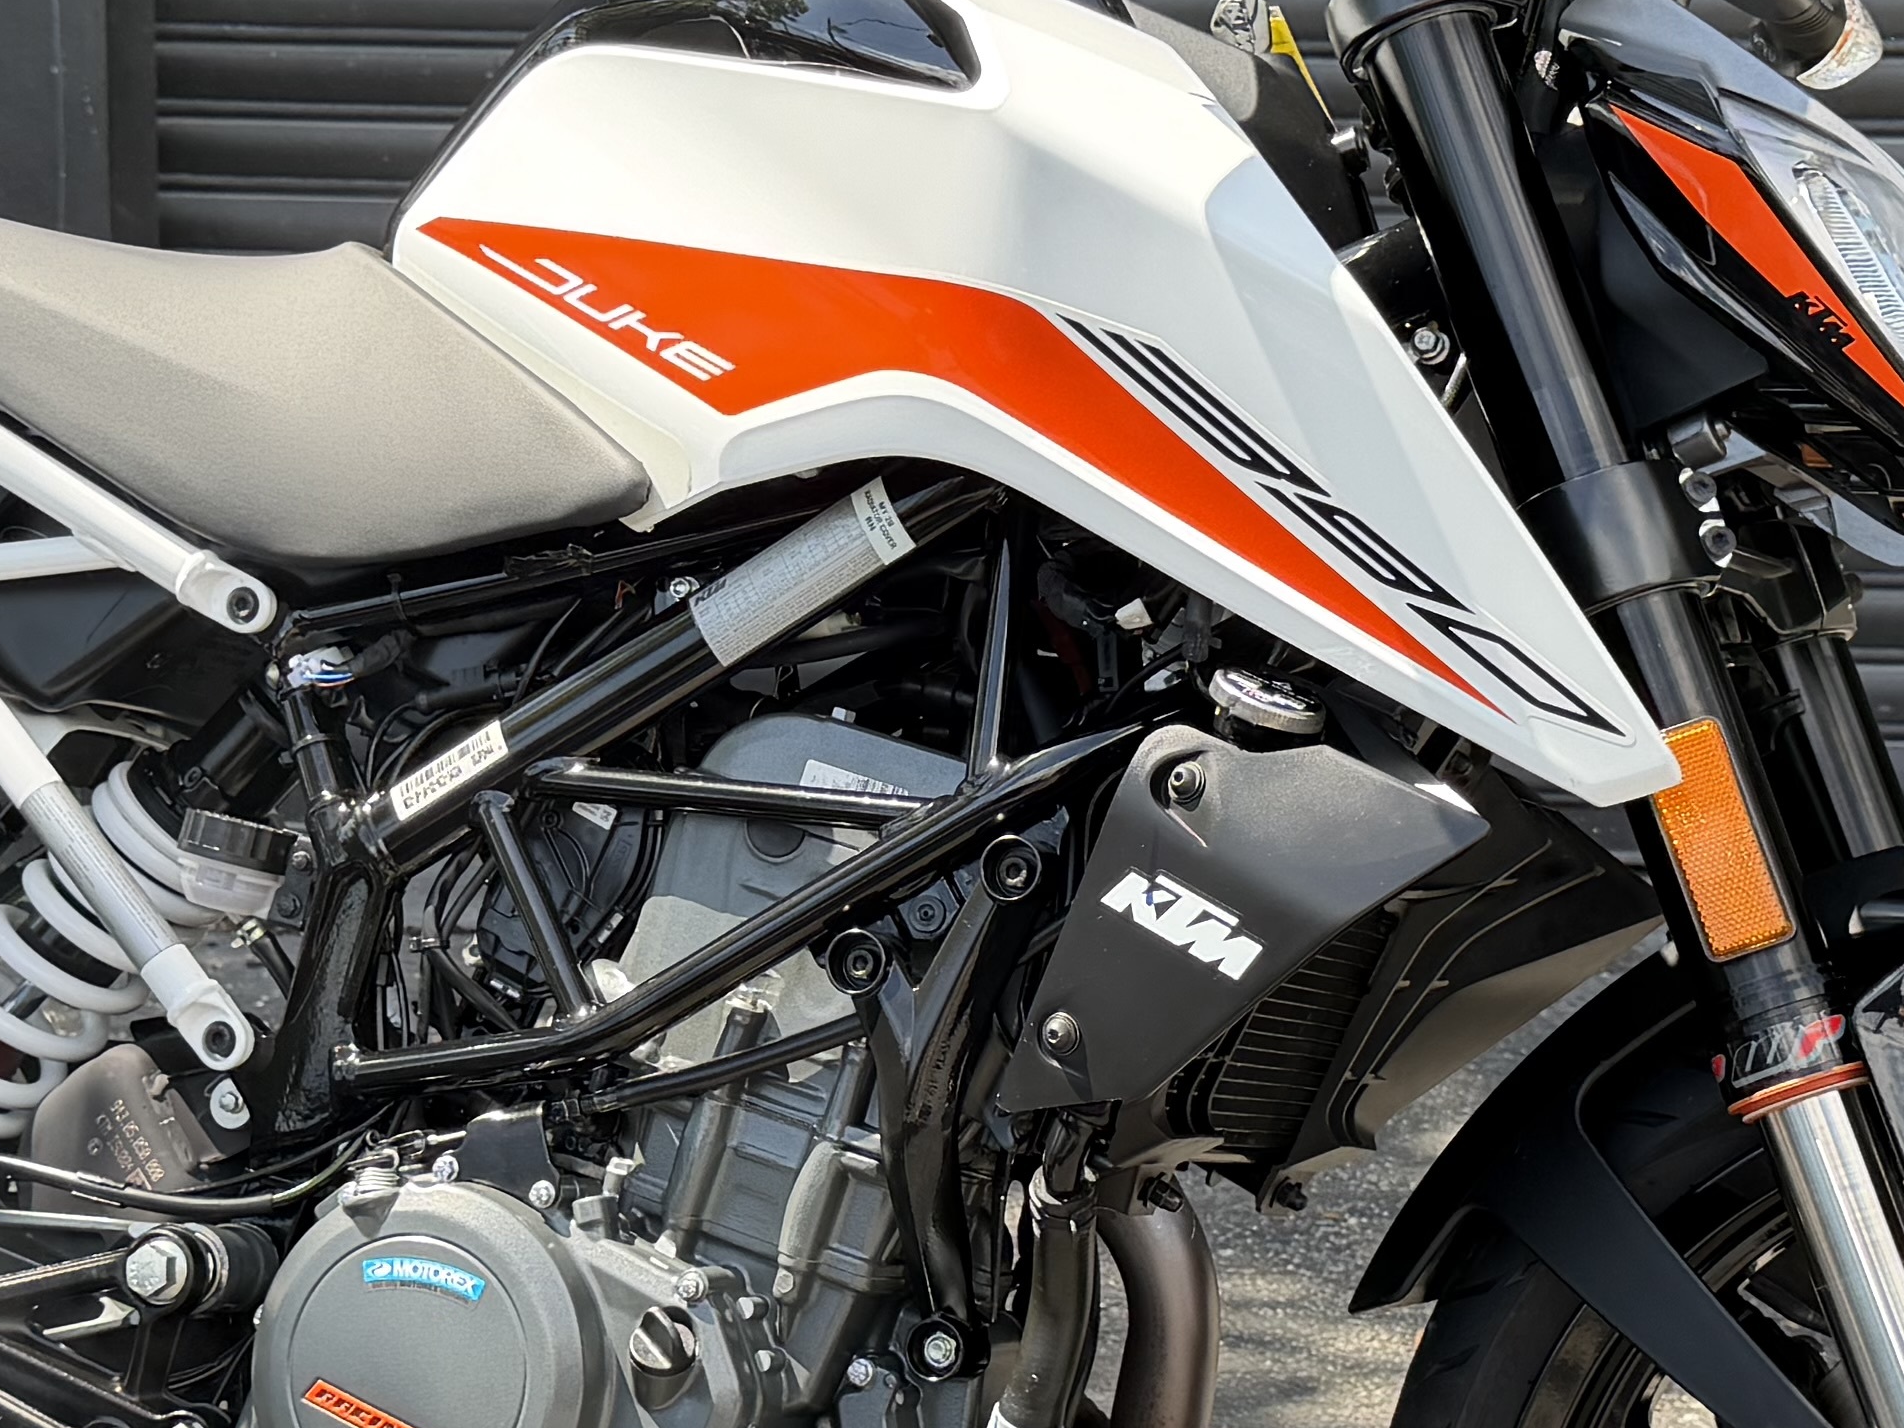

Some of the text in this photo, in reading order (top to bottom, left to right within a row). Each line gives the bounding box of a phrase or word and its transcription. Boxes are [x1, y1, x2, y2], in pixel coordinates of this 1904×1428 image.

[479, 243, 734, 382] DUKE
[1783, 291, 1855, 351] KTM
[1056, 312, 1625, 736] 390
[1100, 871, 1264, 981] KTM
[393, 1258, 478, 1296] MOTOREX
